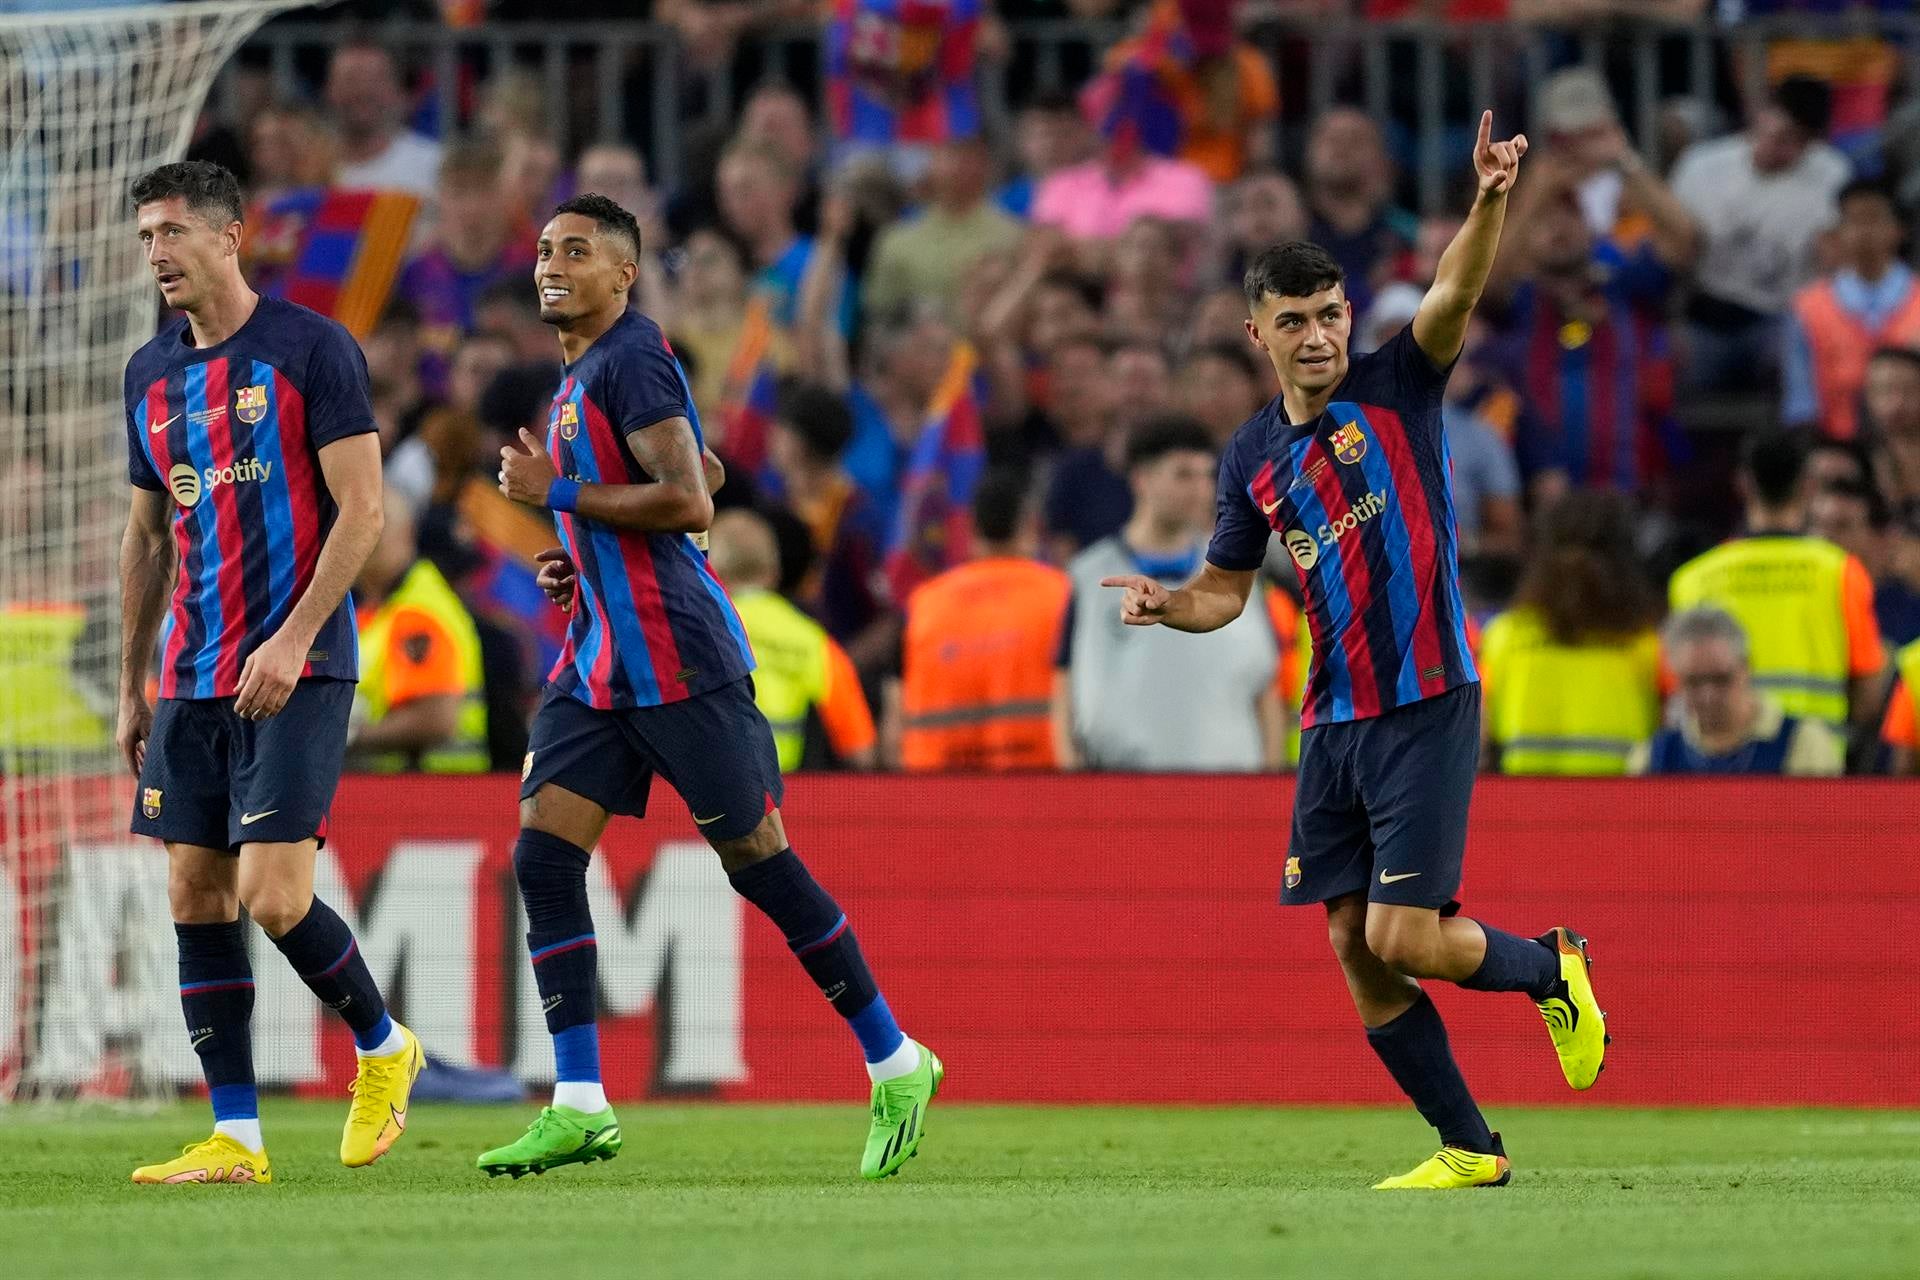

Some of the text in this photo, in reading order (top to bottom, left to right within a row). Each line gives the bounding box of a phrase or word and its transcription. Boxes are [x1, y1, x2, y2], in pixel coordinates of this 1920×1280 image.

[204, 458, 272, 489] Spotify
[1318, 489, 1386, 545] Spotify
[0, 841, 746, 1085] AMM
